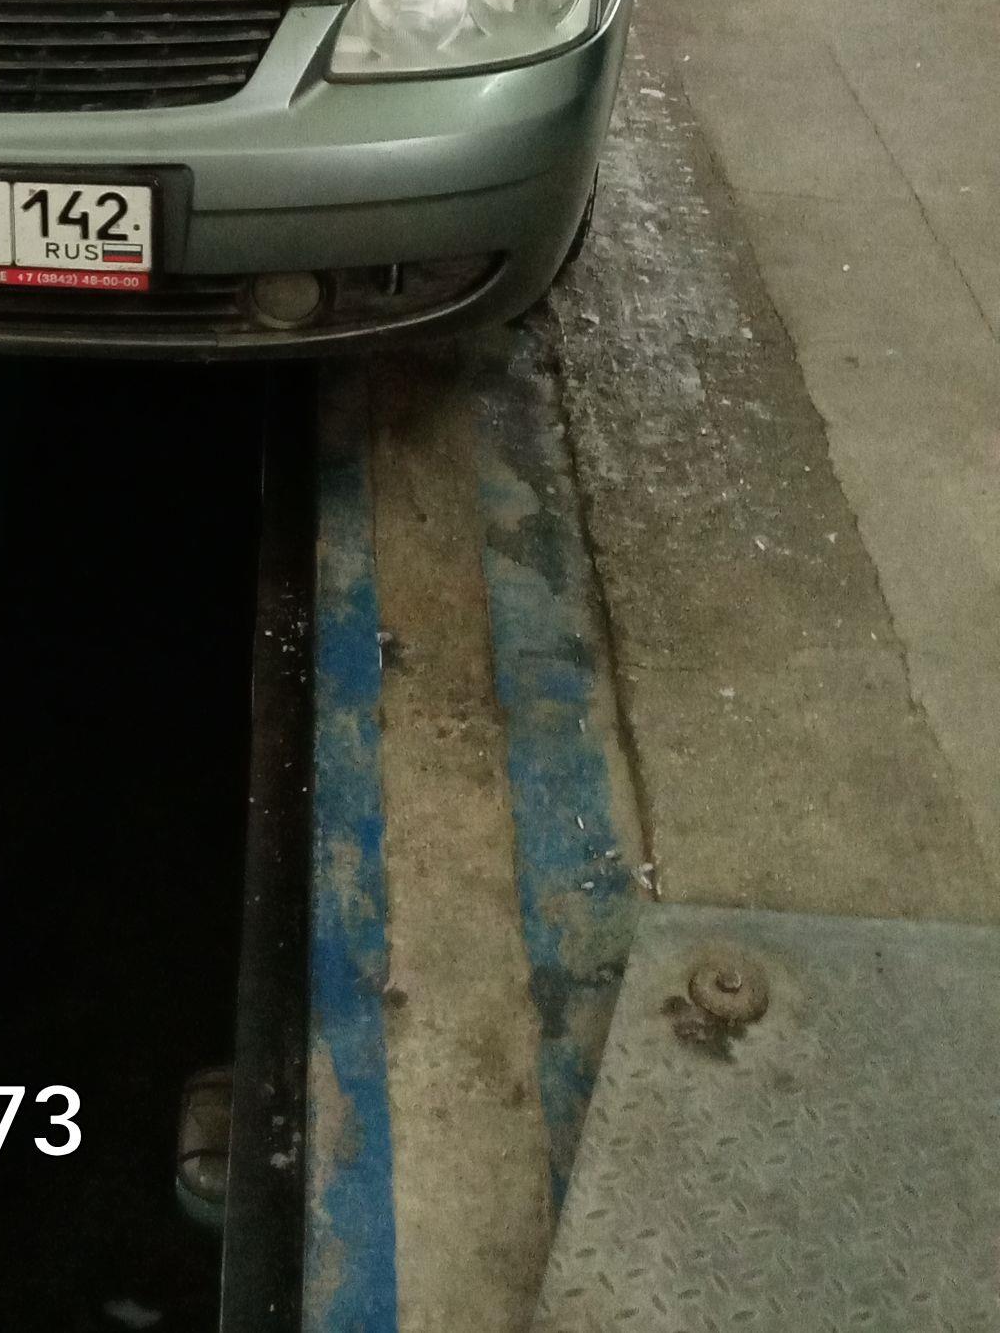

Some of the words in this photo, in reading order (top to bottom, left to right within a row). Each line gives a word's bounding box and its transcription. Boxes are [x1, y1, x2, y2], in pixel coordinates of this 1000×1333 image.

[21, 189, 129, 242] 142
[45, 242, 99, 261] RUS
[36, 273, 78, 286] (3842)
[81, 275, 140, 288] 48-00-00
